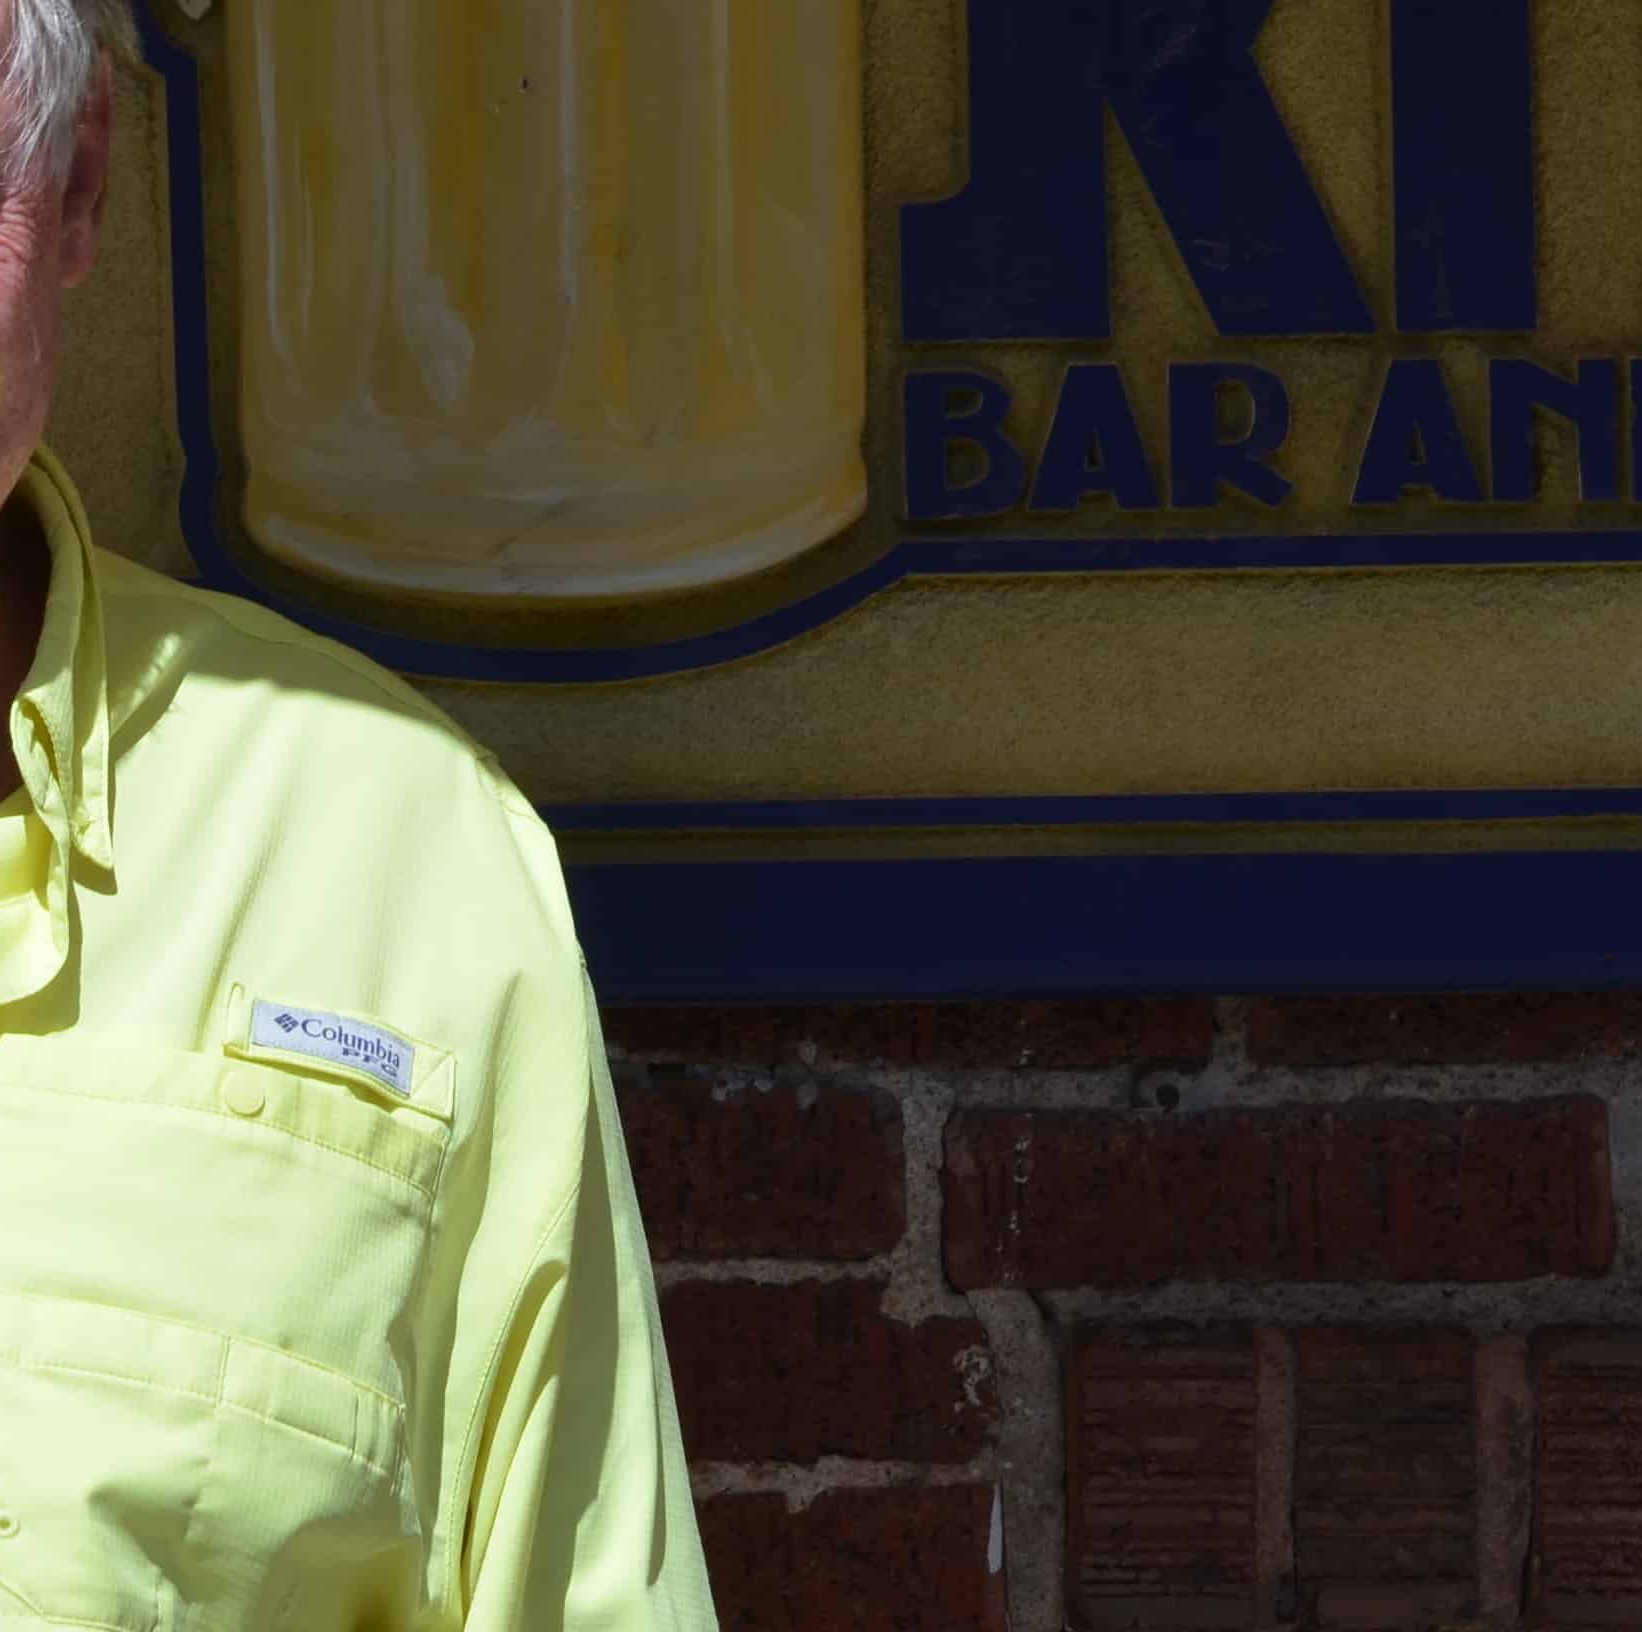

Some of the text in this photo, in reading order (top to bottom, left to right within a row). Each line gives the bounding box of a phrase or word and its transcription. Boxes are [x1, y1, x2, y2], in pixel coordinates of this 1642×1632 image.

[904, 359, 1293, 520] BAR
[301, 1018, 400, 1069] Columbia
[342, 1047, 398, 1078] PFG
